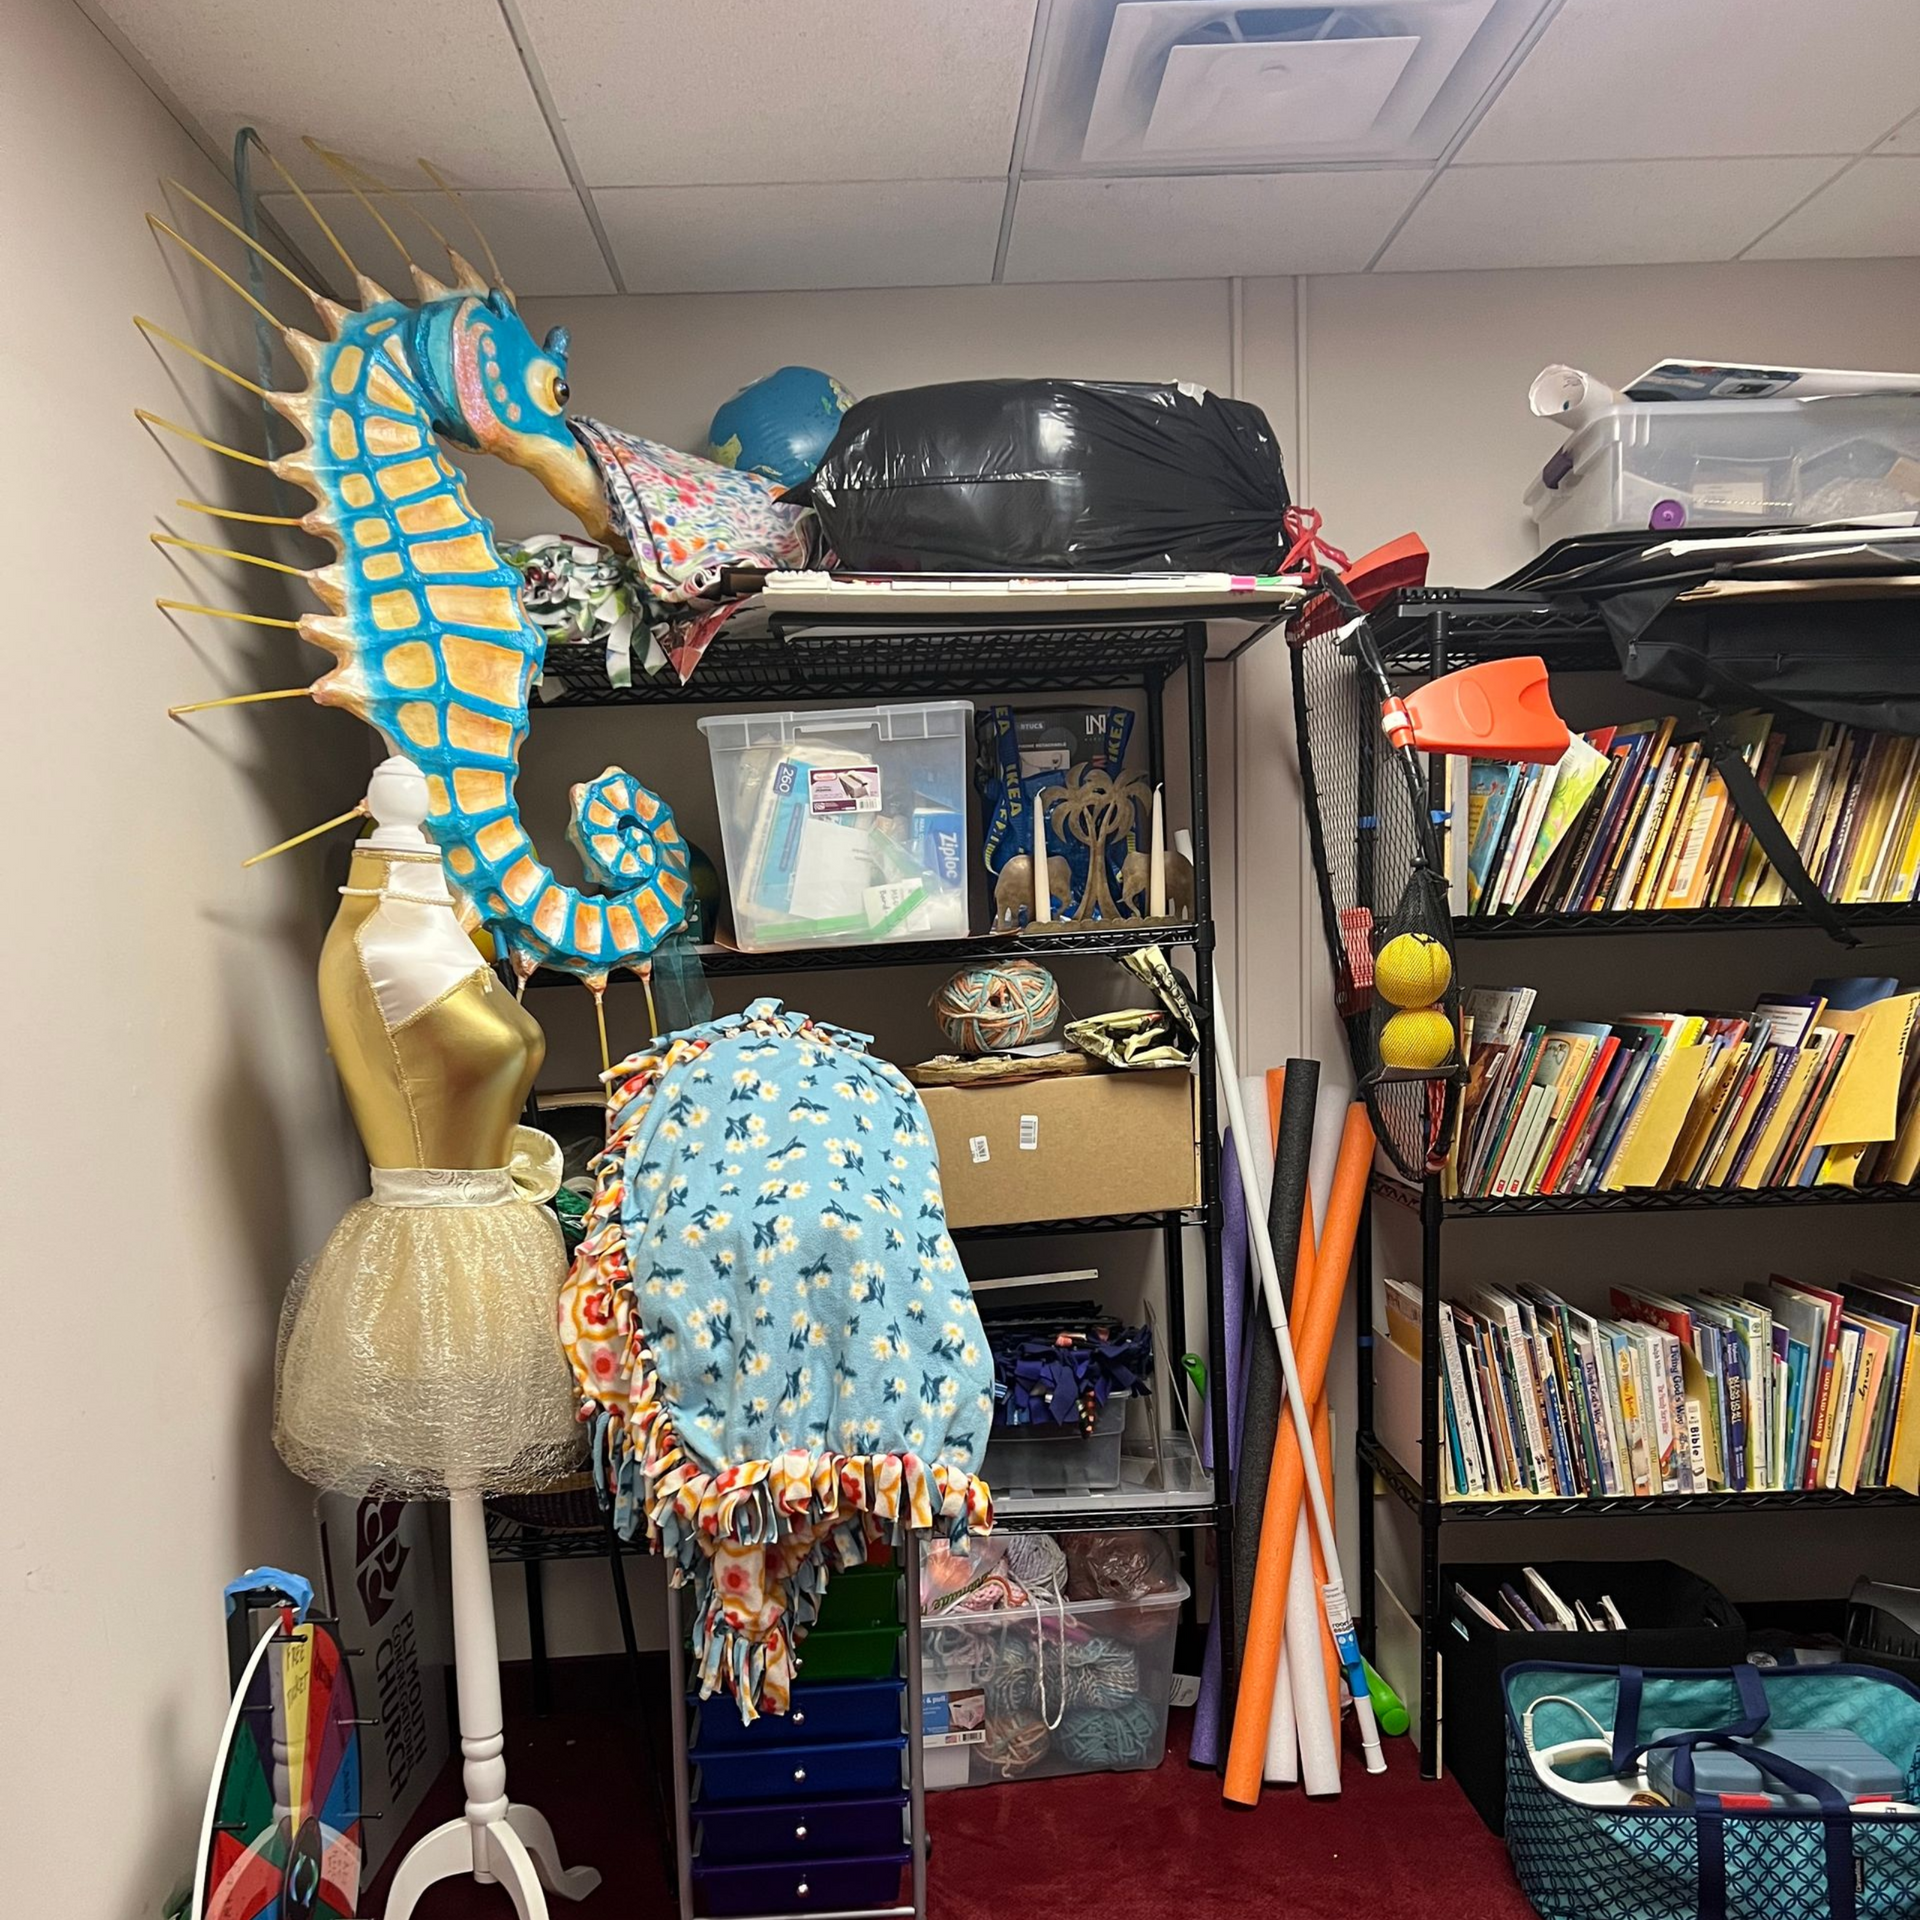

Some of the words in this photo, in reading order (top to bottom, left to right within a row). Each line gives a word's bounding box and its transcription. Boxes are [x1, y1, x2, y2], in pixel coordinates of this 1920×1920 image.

[996, 707, 1011, 735] EA
[1108, 712, 1127, 763] IKEA
[779, 767, 794, 793] 260
[1006, 763, 1022, 817] IKEA
[1585, 816, 1597, 831] THE
[938, 831, 960, 879] Ziploc
[1567, 831, 1592, 870] BEGINNING
[1637, 1342, 1647, 1367] Children
[1650, 1343, 1661, 1359] Ralph
[1667, 1344, 1681, 1373] Living
[1583, 1361, 1596, 1385] Living
[1652, 1359, 1664, 1377] Milton
[1822, 1371, 1831, 1389] GOD
[1856, 1351, 1875, 1401] Family
[1641, 1374, 1650, 1389] God
[1672, 1375, 1684, 1402] God's
[1588, 1385, 1600, 1407] God's
[1656, 1392, 1668, 1410] Family
[1819, 1391, 1828, 1410] SAID
[1591, 1408, 1602, 1425] Way
[1609, 1377, 1618, 1390] God
[1619, 1447, 1628, 1464] TUTU
[1673, 1404, 1686, 1425] Way
[1815, 1412, 1825, 1437] AMEN
[1688, 1426, 1702, 1456] Bible
[1649, 1446, 1658, 1463] TUTU
[285, 1643, 305, 1672] FREE
[392, 1623, 415, 1776] CONGREGATIONAL
[401, 1609, 428, 1764] PLYMOUTH
[376, 1638, 409, 1804] CHURCH
